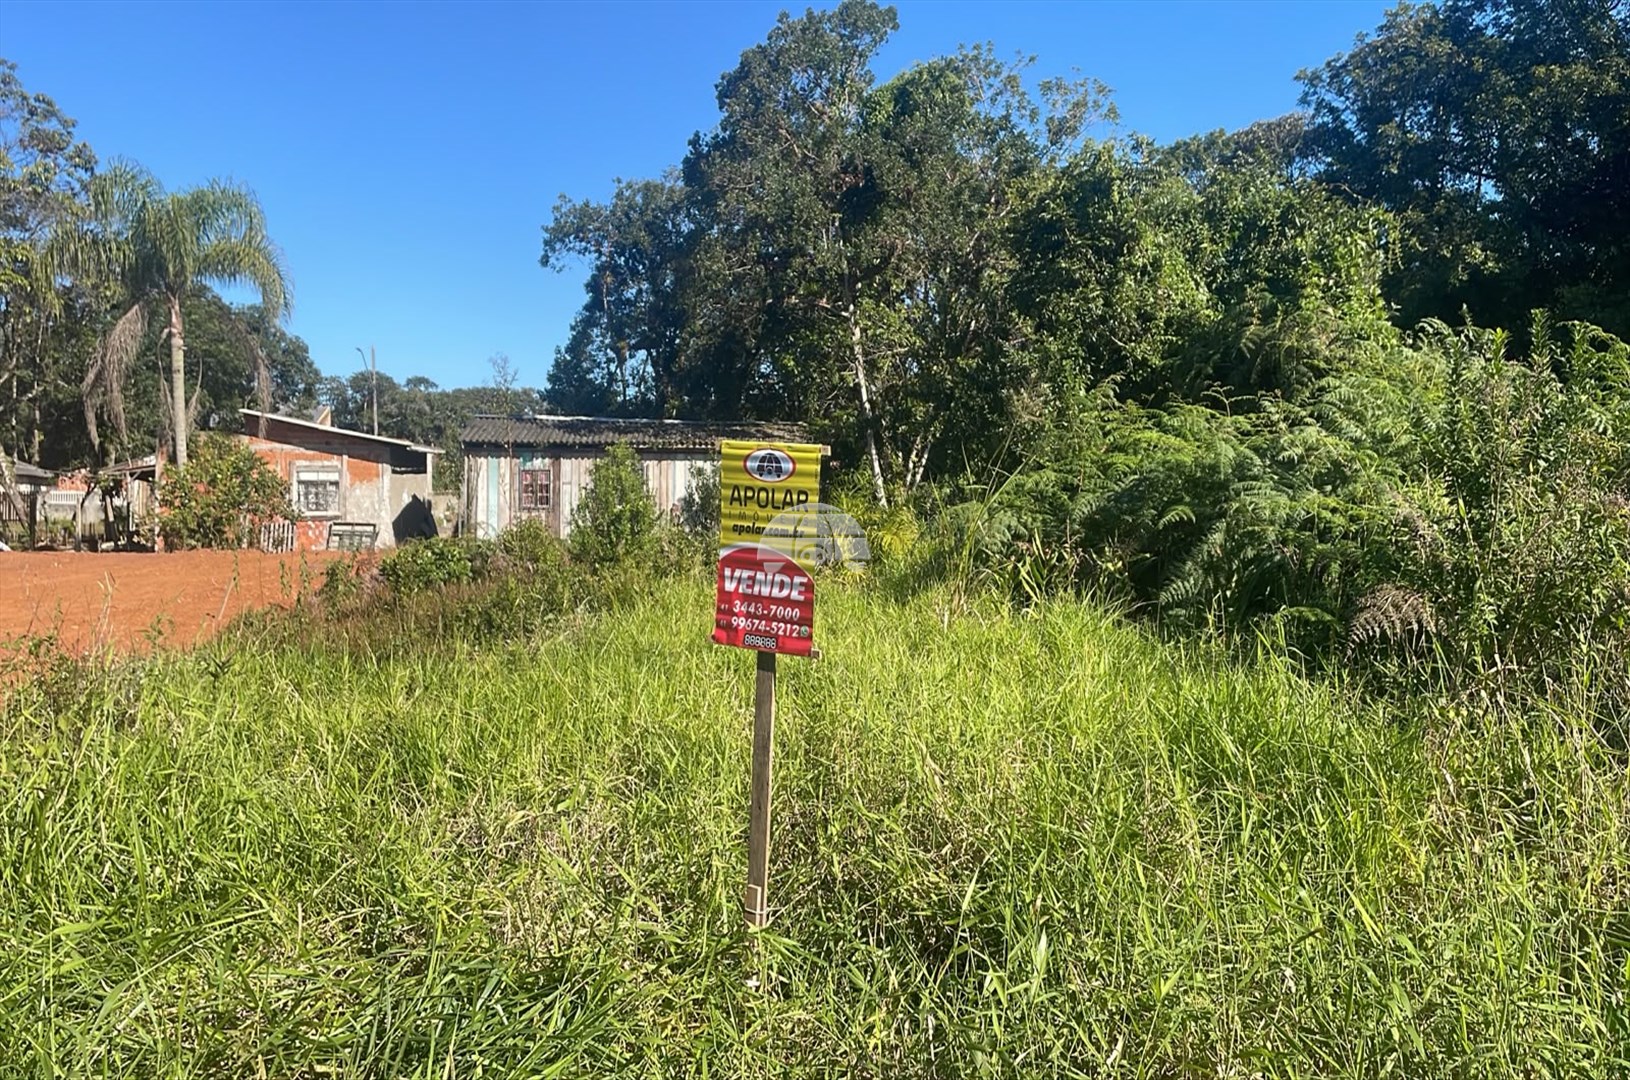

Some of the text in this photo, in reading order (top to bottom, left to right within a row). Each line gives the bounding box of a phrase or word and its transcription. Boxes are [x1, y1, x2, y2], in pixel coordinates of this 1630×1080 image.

[729, 485, 809, 513] APOLAR
[724, 567, 809, 602] VENDE
[733, 600, 800, 621] 3443-7000
[731, 616, 799, 637] 99674-5212
